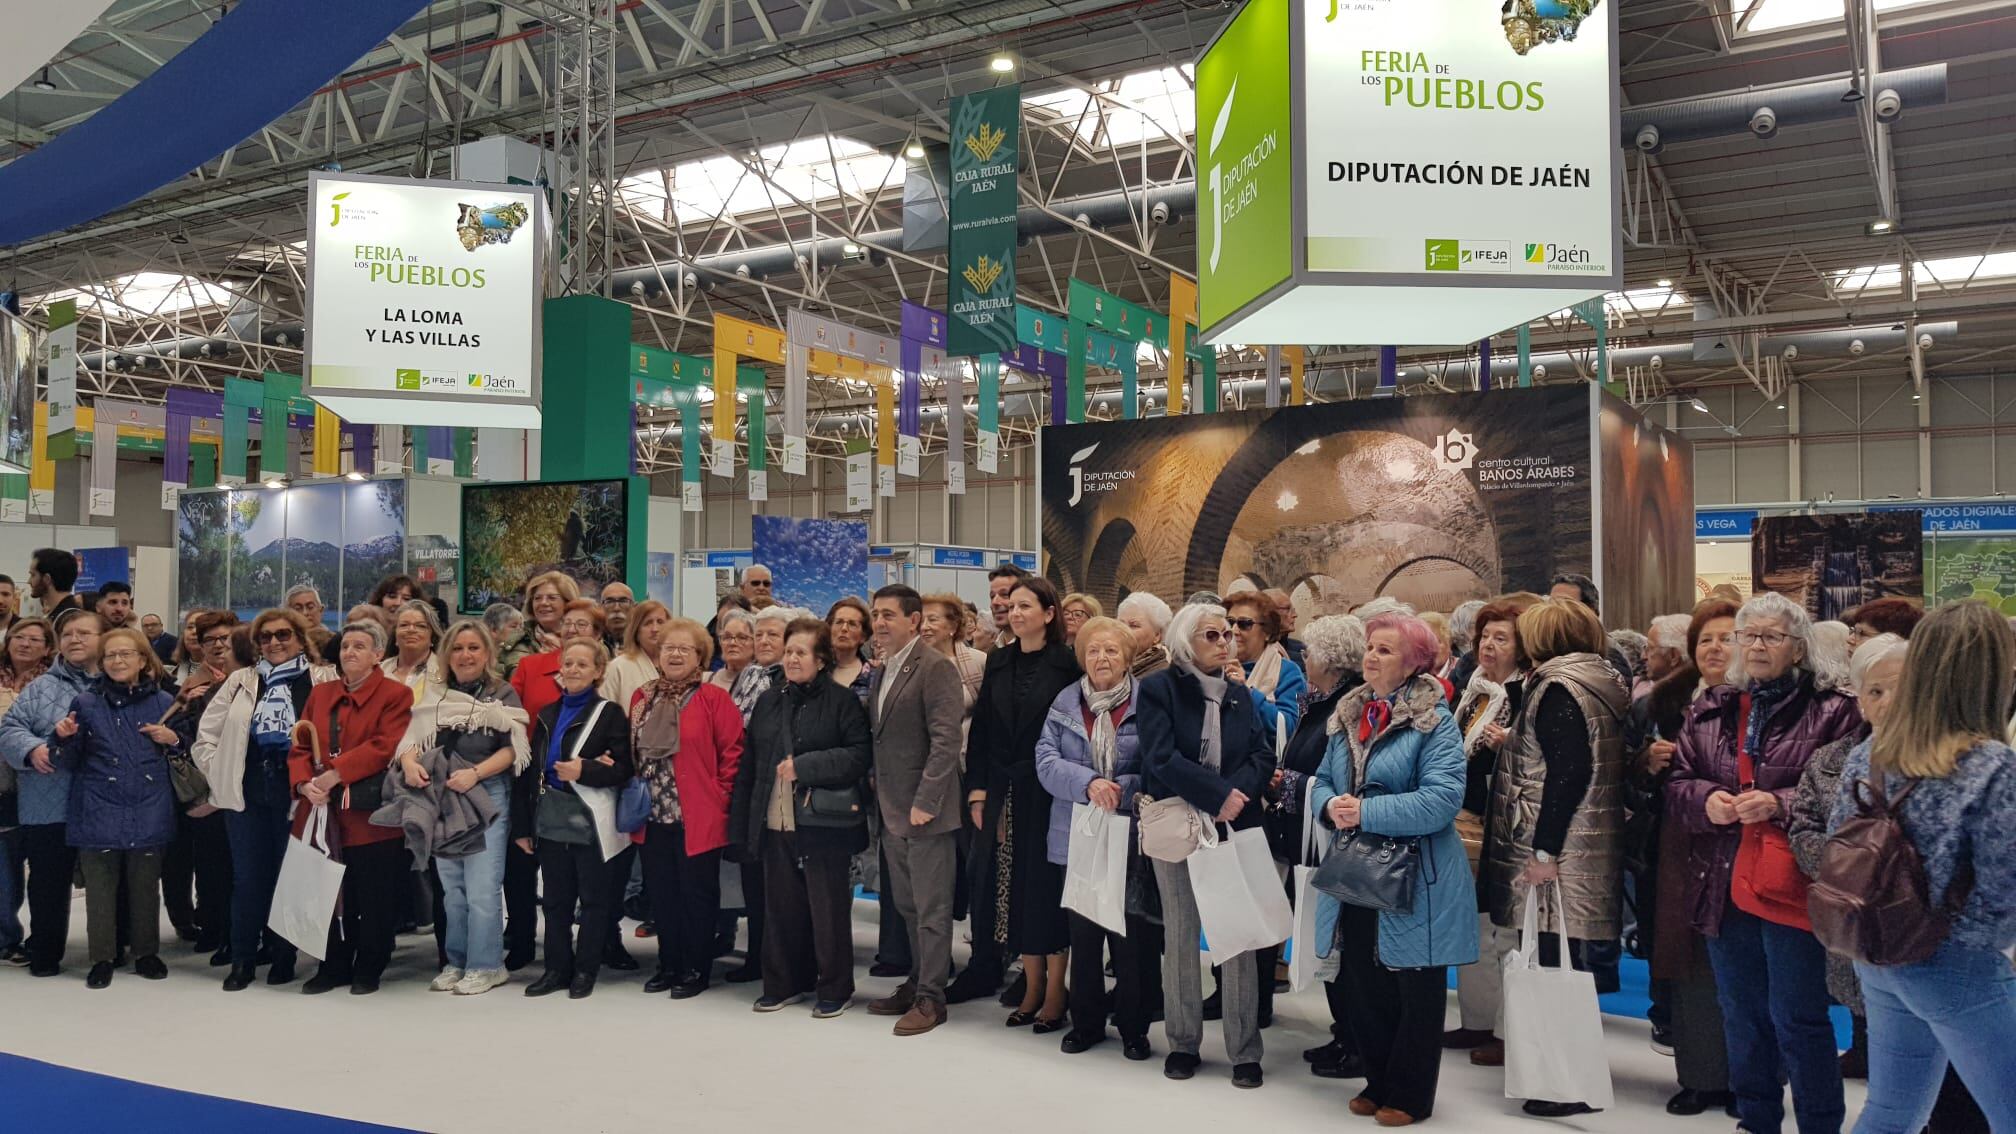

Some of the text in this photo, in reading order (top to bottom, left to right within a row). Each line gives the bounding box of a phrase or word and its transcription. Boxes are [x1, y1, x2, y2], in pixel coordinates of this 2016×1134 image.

[1361, 50, 1450, 75] FERIA DE
[1361, 76, 1545, 112] LOS PUEBLOS
[1223, 129, 1277, 195] DIPUTACIÓN
[955, 162, 1015, 182] CAJA RURAL
[1328, 160, 1591, 187] DIPUTACIÓN DE JAÉN
[971, 179, 997, 194] JAÉN
[1223, 177, 1258, 224] DE JAÉN
[952, 215, 1017, 231] www.ruralvia.com
[355, 246, 404, 262] FERIA
[1475, 250, 1508, 260] IFEJA
[1547, 244, 1589, 263] Jaén
[354, 261, 486, 289] LOS PUEBLOS
[953, 296, 1013, 313] CAJA RURAL
[384, 308, 464, 326] LA LOMA
[969, 311, 995, 326] JAÉN
[366, 329, 481, 348] Y LAS VILLAS
[432, 377, 456, 385] IFEJA
[483, 374, 515, 389] Jaén
[1478, 456, 1550, 469] centro cultural
[1084, 470, 1136, 482] DIPUTACIÓN
[1479, 465, 1575, 482] BAÑOS ÁRABES
[1084, 482, 1118, 492] DE JAÉN
[1706, 519, 1738, 529] VEGA
[1930, 519, 1980, 530] DE JAÉN
